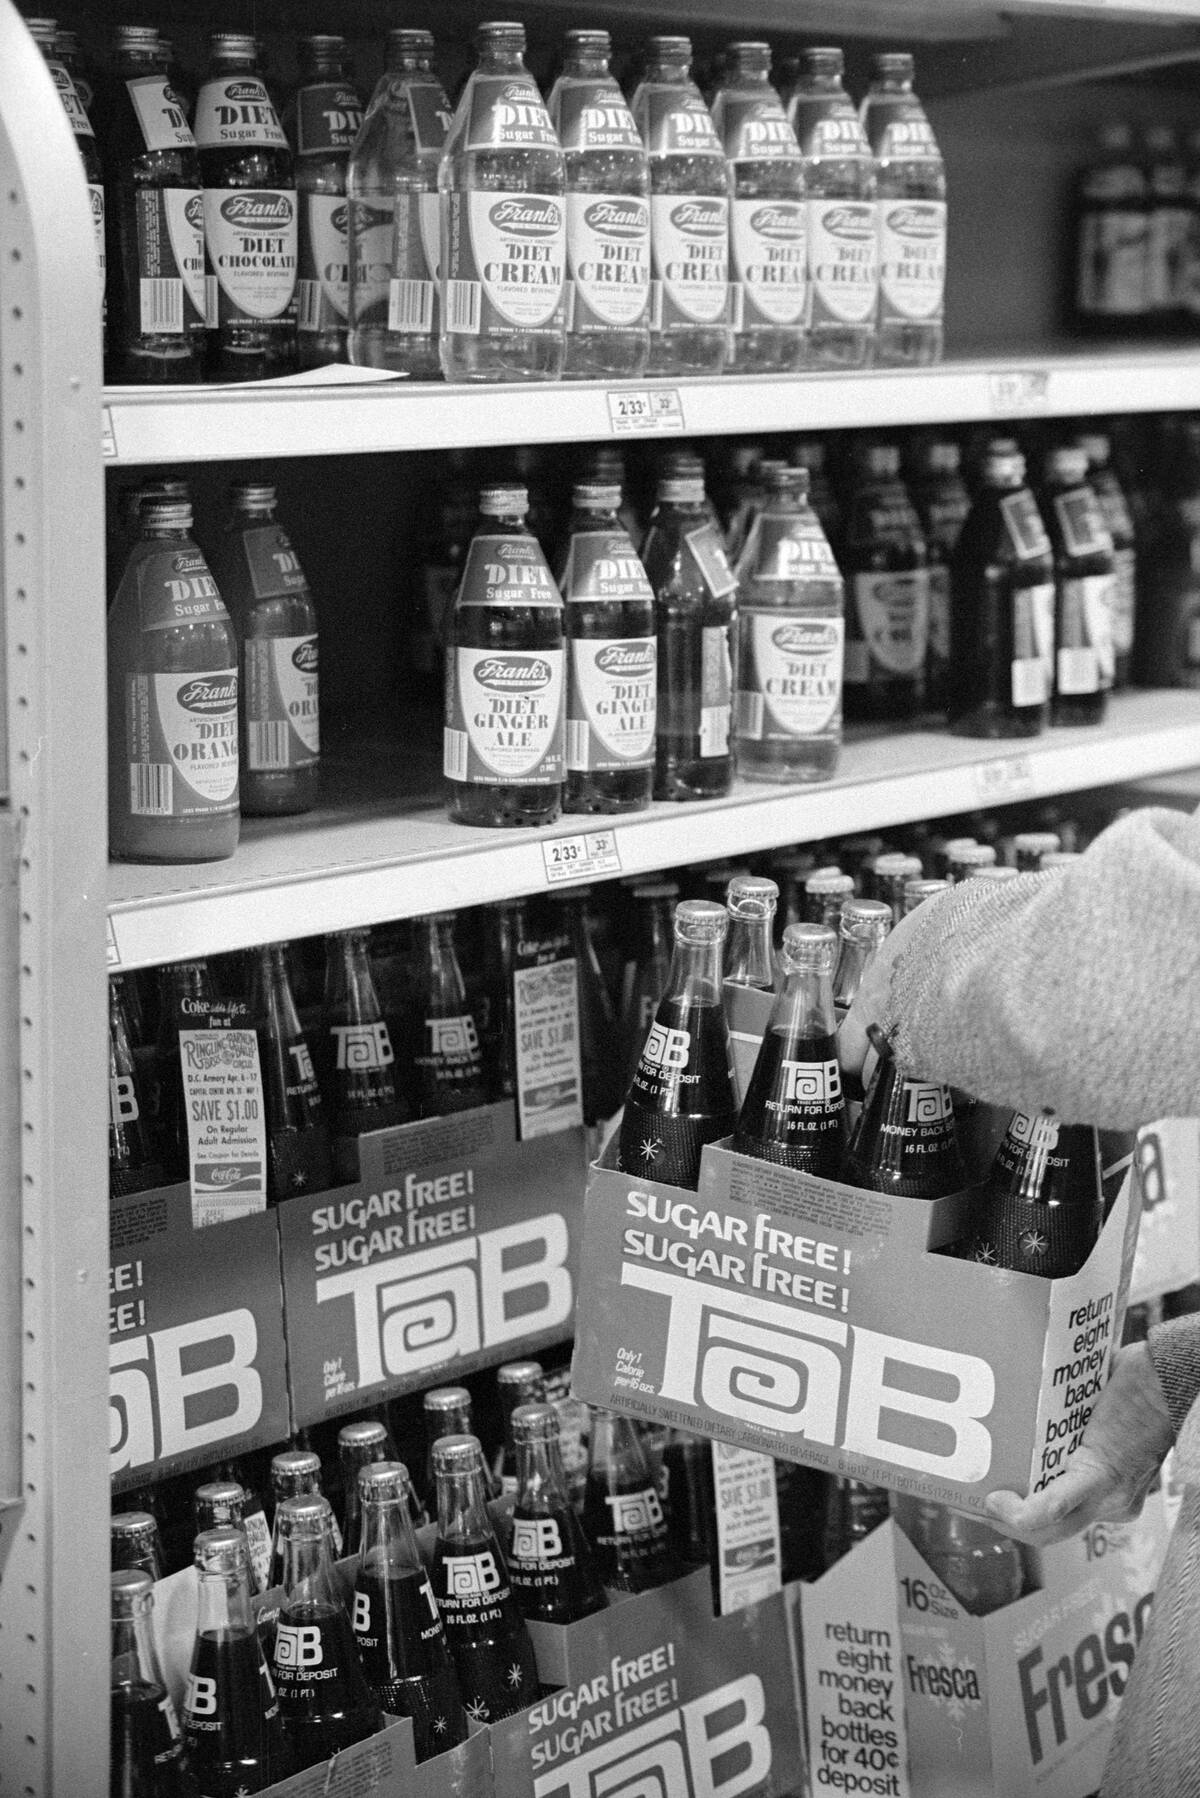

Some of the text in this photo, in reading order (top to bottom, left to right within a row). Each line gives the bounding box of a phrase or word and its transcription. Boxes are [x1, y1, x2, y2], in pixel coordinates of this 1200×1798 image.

[581, 108, 637, 129] DIE
[220, 128, 257, 140] Sugar
[499, 130, 534, 142] Sugar
[226, 196, 290, 216] Frank's
[494, 201, 560, 224] Frank's
[239, 237, 286, 253] DIET
[505, 244, 553, 262] DIET
[600, 243, 642, 262] DIET
[665, 262, 728, 283] CREA
[746, 265, 807, 283] CREA
[484, 564, 549, 586] DIET
[164, 576, 219, 602] DIE
[486, 586, 523, 601] Sugar
[174, 601, 211, 617] Sugar
[478, 660, 546, 680] Frank's
[489, 698, 540, 714] DIET
[473, 713, 549, 729] GINGER
[492, 732, 533, 747] ALE
[172, 740, 238, 761] ORANG
[181, 997, 210, 1014] Coke
[658, 1071, 702, 1084] DEPOSIT
[192, 1099, 259, 1122] SAVE $1.00
[765, 1097, 846, 1116] RETURN FOR DEPOS
[206, 1124, 248, 1135] On Regular
[786, 1119, 796, 1131] 16
[880, 1123, 918, 1137] MONEY
[199, 1135, 258, 1145] Adult Admission
[311, 1189, 403, 1236] SUGAR
[626, 1190, 748, 1247] SUGAR
[314, 1225, 406, 1273] SUGAR
[623, 1228, 746, 1284] SUGAR
[1068, 1292, 1113, 1330] return
[1073, 1315, 1110, 1354] eight
[617, 1347, 637, 1367] Only
[1053, 1345, 1108, 1387] money
[616, 1360, 645, 1378] Calorie
[1064, 1371, 1103, 1408] back
[609, 1394, 658, 1416] ARTIFICIALLY
[658, 1407, 703, 1431] SWEETENED
[704, 1418, 737, 1441] DIETARY
[1045, 1404, 1093, 1444] bottle
[1041, 1445, 1066, 1472] for
[1082, 1523, 1108, 1563] 16
[462, 1596, 481, 1609] FOR
[900, 1576, 930, 1612] 16
[930, 1600, 960, 1620] Size
[356, 1637, 380, 1648] POSIT
[825, 1620, 891, 1648] return
[836, 1645, 893, 1675] eight
[277, 1667, 339, 1681] FOR DEPOSIT
[818, 1669, 894, 1700] money
[906, 1654, 981, 1701] Fresca
[528, 1674, 610, 1736] SUGAR
[838, 1692, 895, 1722] back
[530, 1709, 613, 1771] SUGAR
[821, 1714, 899, 1749] bottles
[820, 1739, 900, 1771] for 40¢
[817, 1763, 901, 1797] deposit
